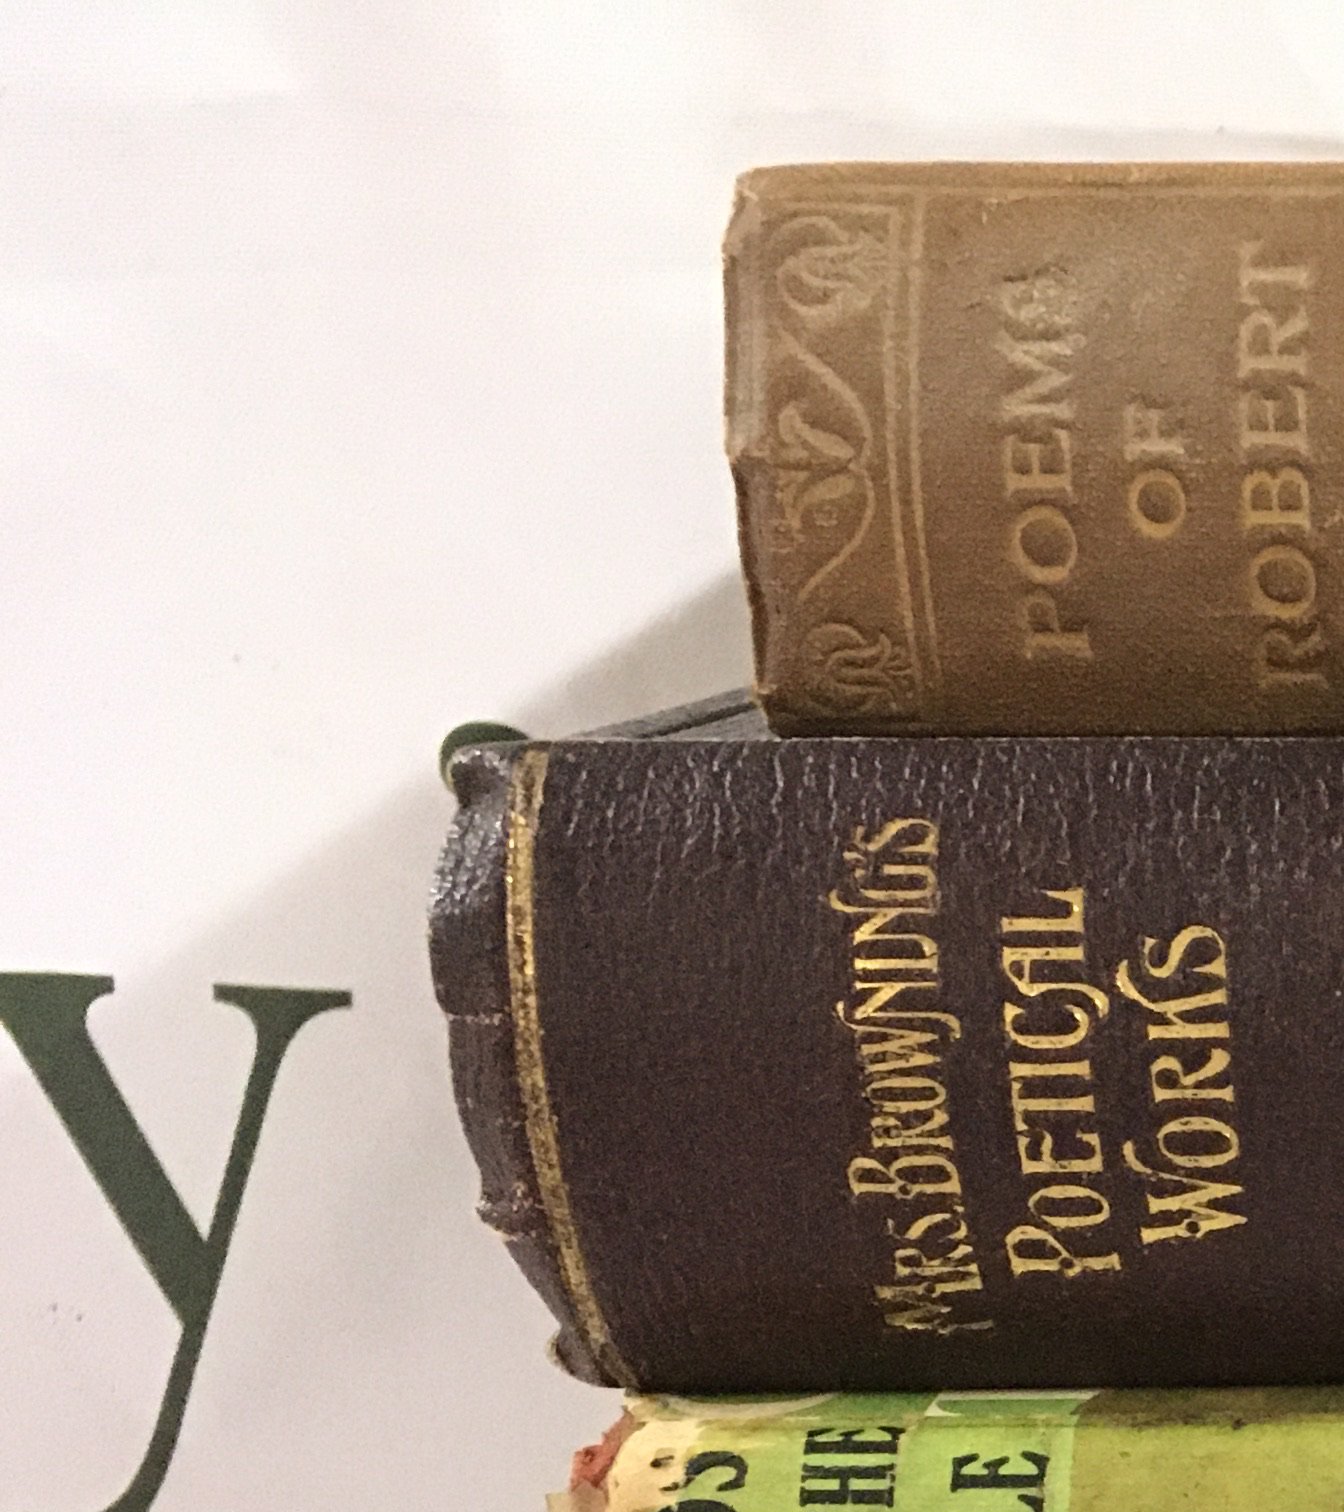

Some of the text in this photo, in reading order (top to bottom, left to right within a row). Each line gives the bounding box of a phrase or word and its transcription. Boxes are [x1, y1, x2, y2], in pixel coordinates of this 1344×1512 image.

[1124, 400, 1190, 539] OF
[1237, 239, 1328, 692] ROBERT
[1000, 886, 1121, 1278] POETICAL
[1115, 924, 1248, 1245] WORKS
